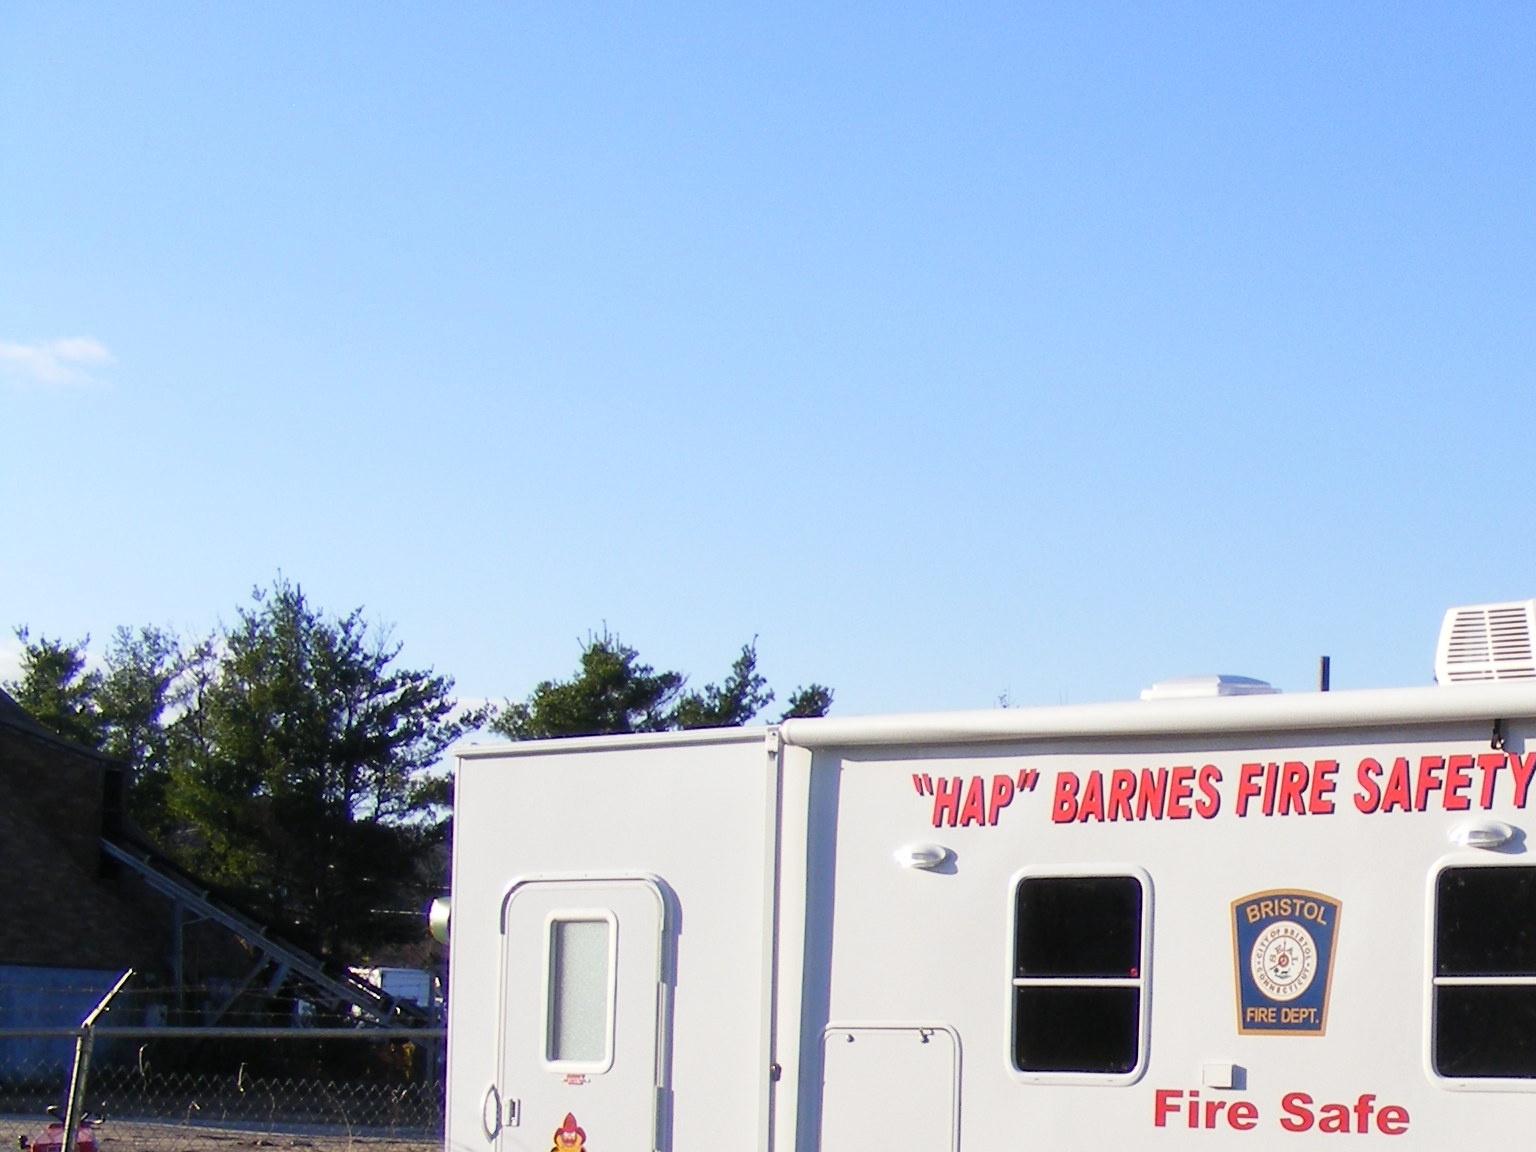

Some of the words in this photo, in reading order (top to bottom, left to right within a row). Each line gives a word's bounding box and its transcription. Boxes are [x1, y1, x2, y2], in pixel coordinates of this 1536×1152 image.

[1051, 763, 1223, 824] BARNES
[1235, 759, 1339, 817] FIRE
[1246, 898, 1327, 925] BRISTOL
[1246, 1007, 1277, 1023] FIRE
[1281, 1007, 1319, 1024] DEPT.
[1154, 1089, 1259, 1130] Fire
[1279, 1092, 1410, 1136] Safe
